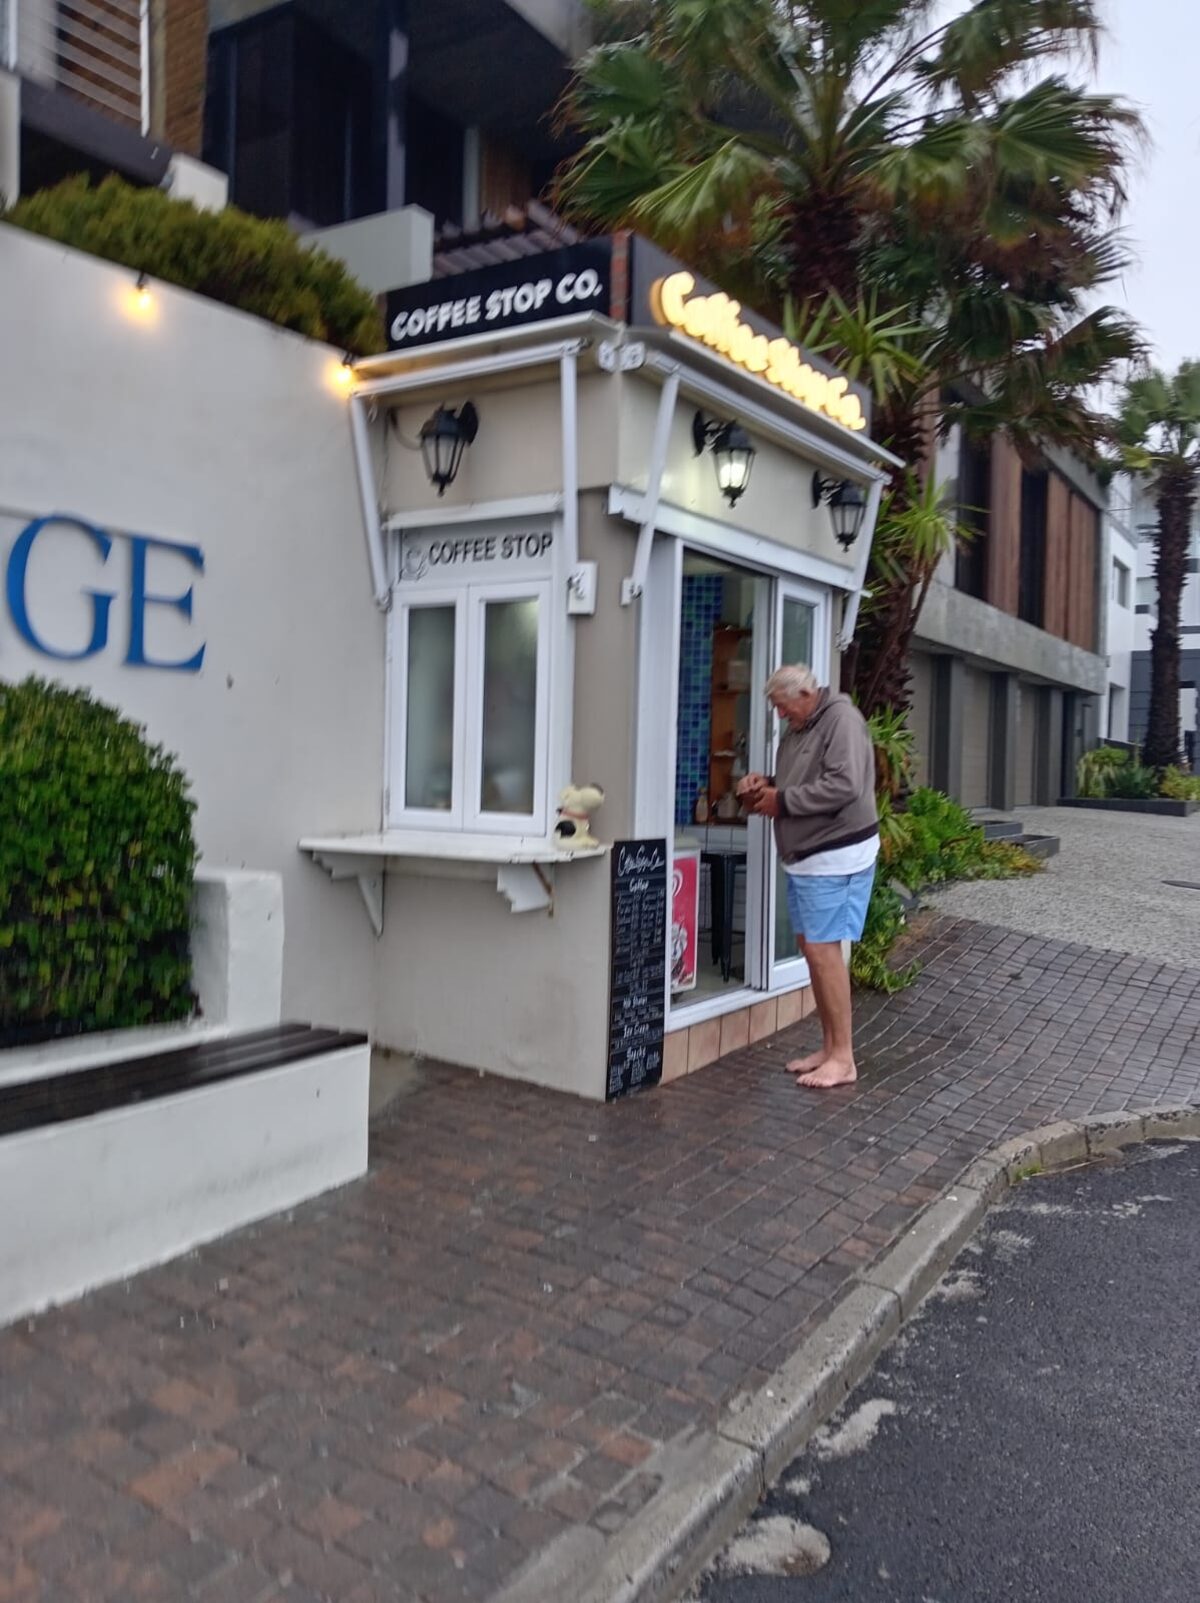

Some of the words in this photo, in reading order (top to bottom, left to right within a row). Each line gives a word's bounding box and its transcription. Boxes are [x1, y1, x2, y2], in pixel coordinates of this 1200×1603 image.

[390, 295, 482, 342] COFFEE
[484, 278, 553, 321] STOP
[555, 268, 603, 304] CO.
[428, 538, 498, 567] COFFEE
[500, 531, 553, 560] STOP
[6, 511, 207, 673] GE
